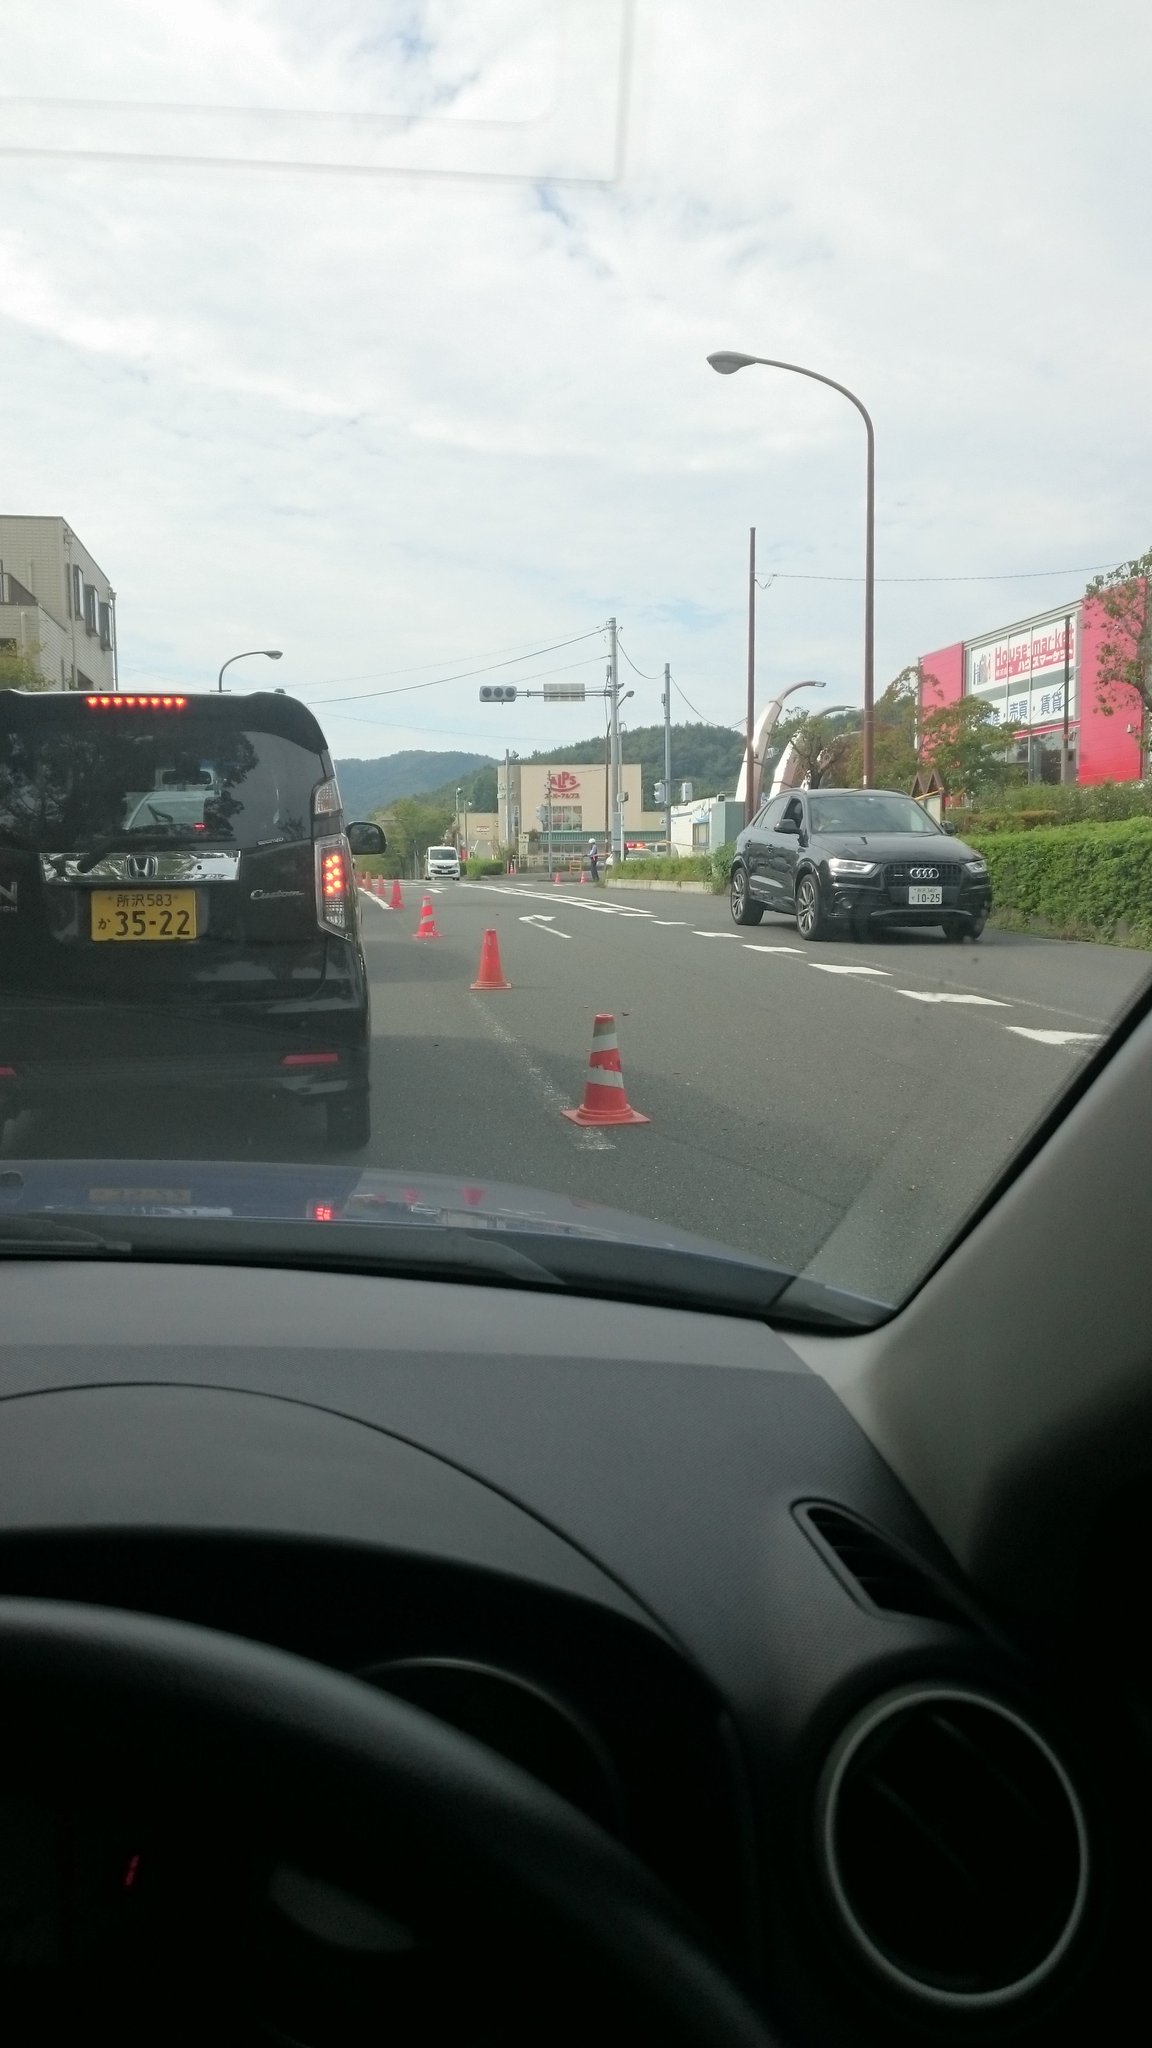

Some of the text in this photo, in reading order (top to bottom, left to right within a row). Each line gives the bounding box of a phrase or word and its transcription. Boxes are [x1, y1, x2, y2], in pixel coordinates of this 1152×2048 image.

[550, 771, 577, 788] ALPS
[250, 889, 304, 900] Custom
[917, 893, 941, 903] 10-25
[115, 910, 190, 936] 35-22
